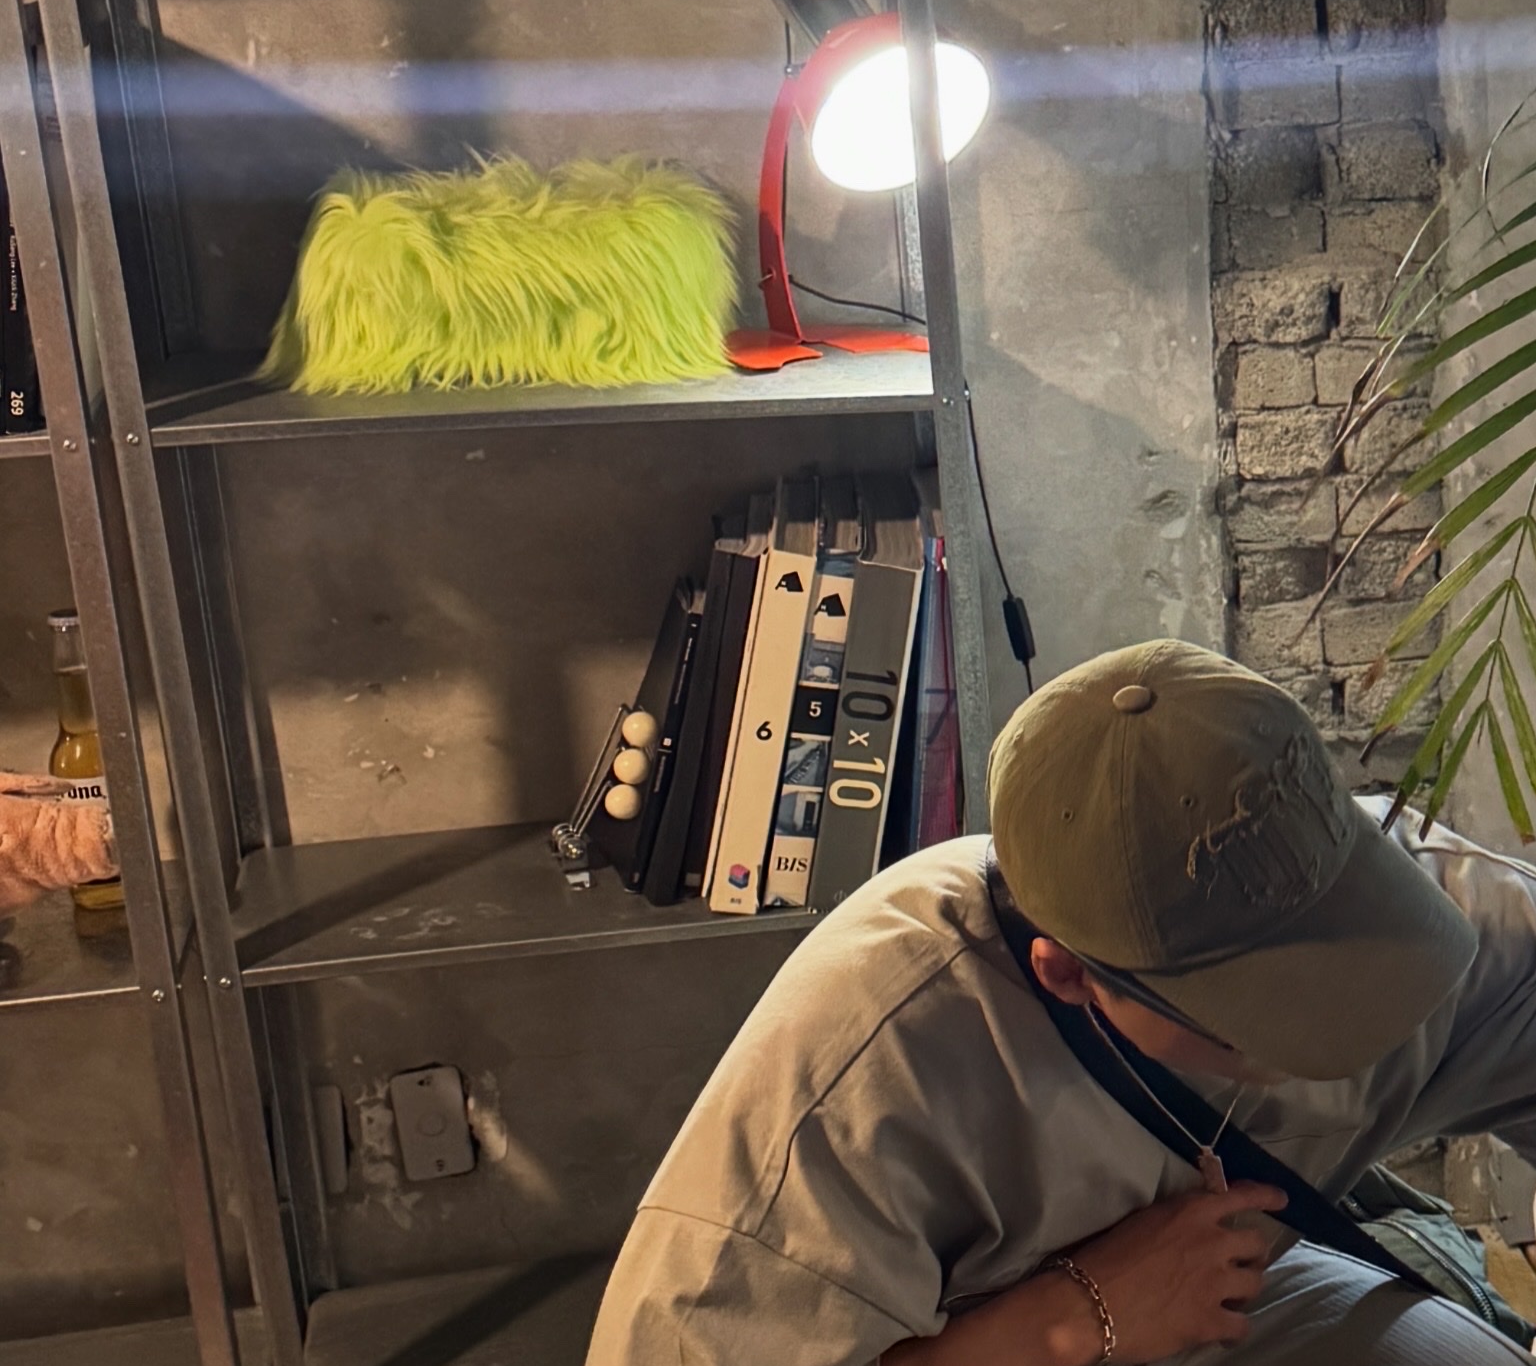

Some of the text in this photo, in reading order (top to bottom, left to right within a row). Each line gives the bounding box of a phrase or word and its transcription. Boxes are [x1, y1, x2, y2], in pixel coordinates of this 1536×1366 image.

[10, 391, 24, 416] 269
[809, 701, 822, 717] 5
[756, 721, 773, 741] 6
